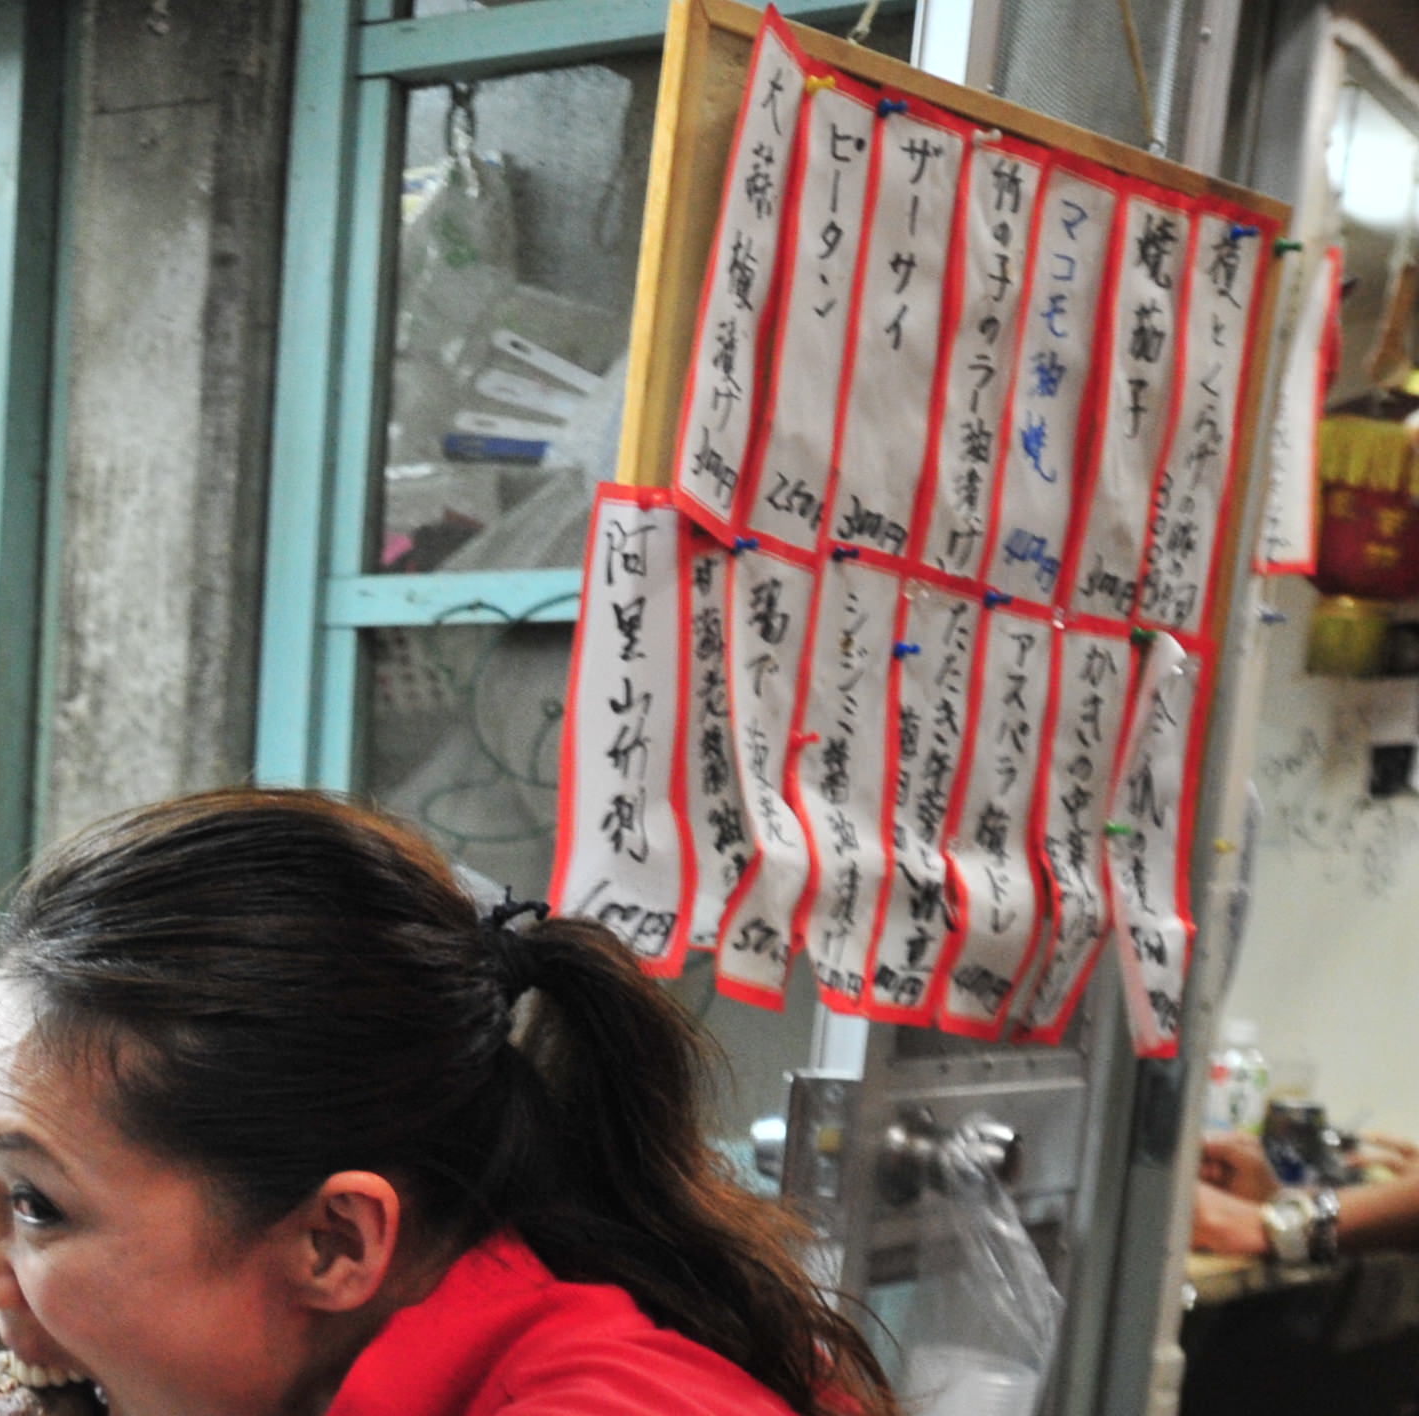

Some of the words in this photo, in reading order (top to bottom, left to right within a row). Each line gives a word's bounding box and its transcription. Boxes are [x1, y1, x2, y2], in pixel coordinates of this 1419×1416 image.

[813, 122, 867, 318] ピータン
[884, 137, 945, 352] ザーサイ
[1124, 213, 1180, 440] 焼茄子
